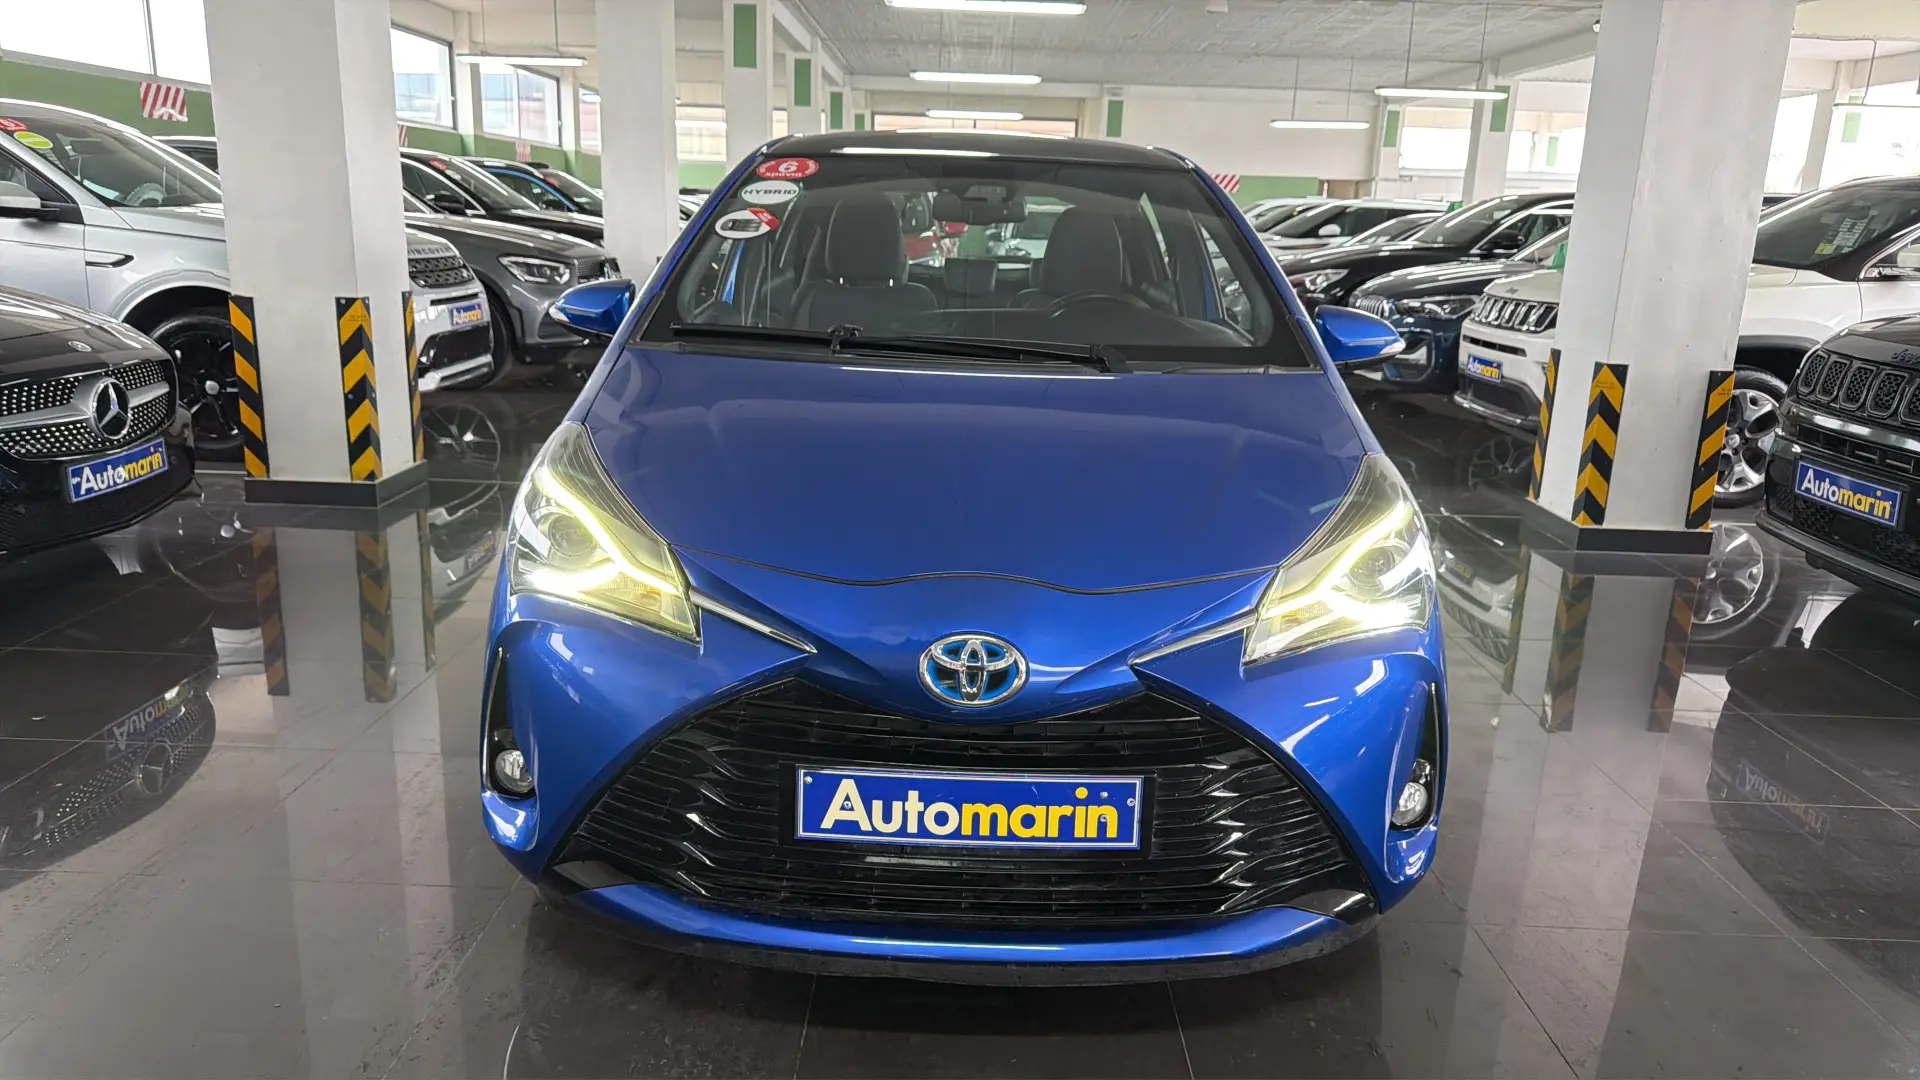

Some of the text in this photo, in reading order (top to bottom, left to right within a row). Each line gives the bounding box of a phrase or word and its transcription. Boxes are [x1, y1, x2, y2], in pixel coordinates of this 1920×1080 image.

[778, 160, 799, 172] 6
[80, 446, 163, 495] Automarin
[1801, 468, 1892, 519] Automarin
[820, 778, 1119, 839] Automarin
